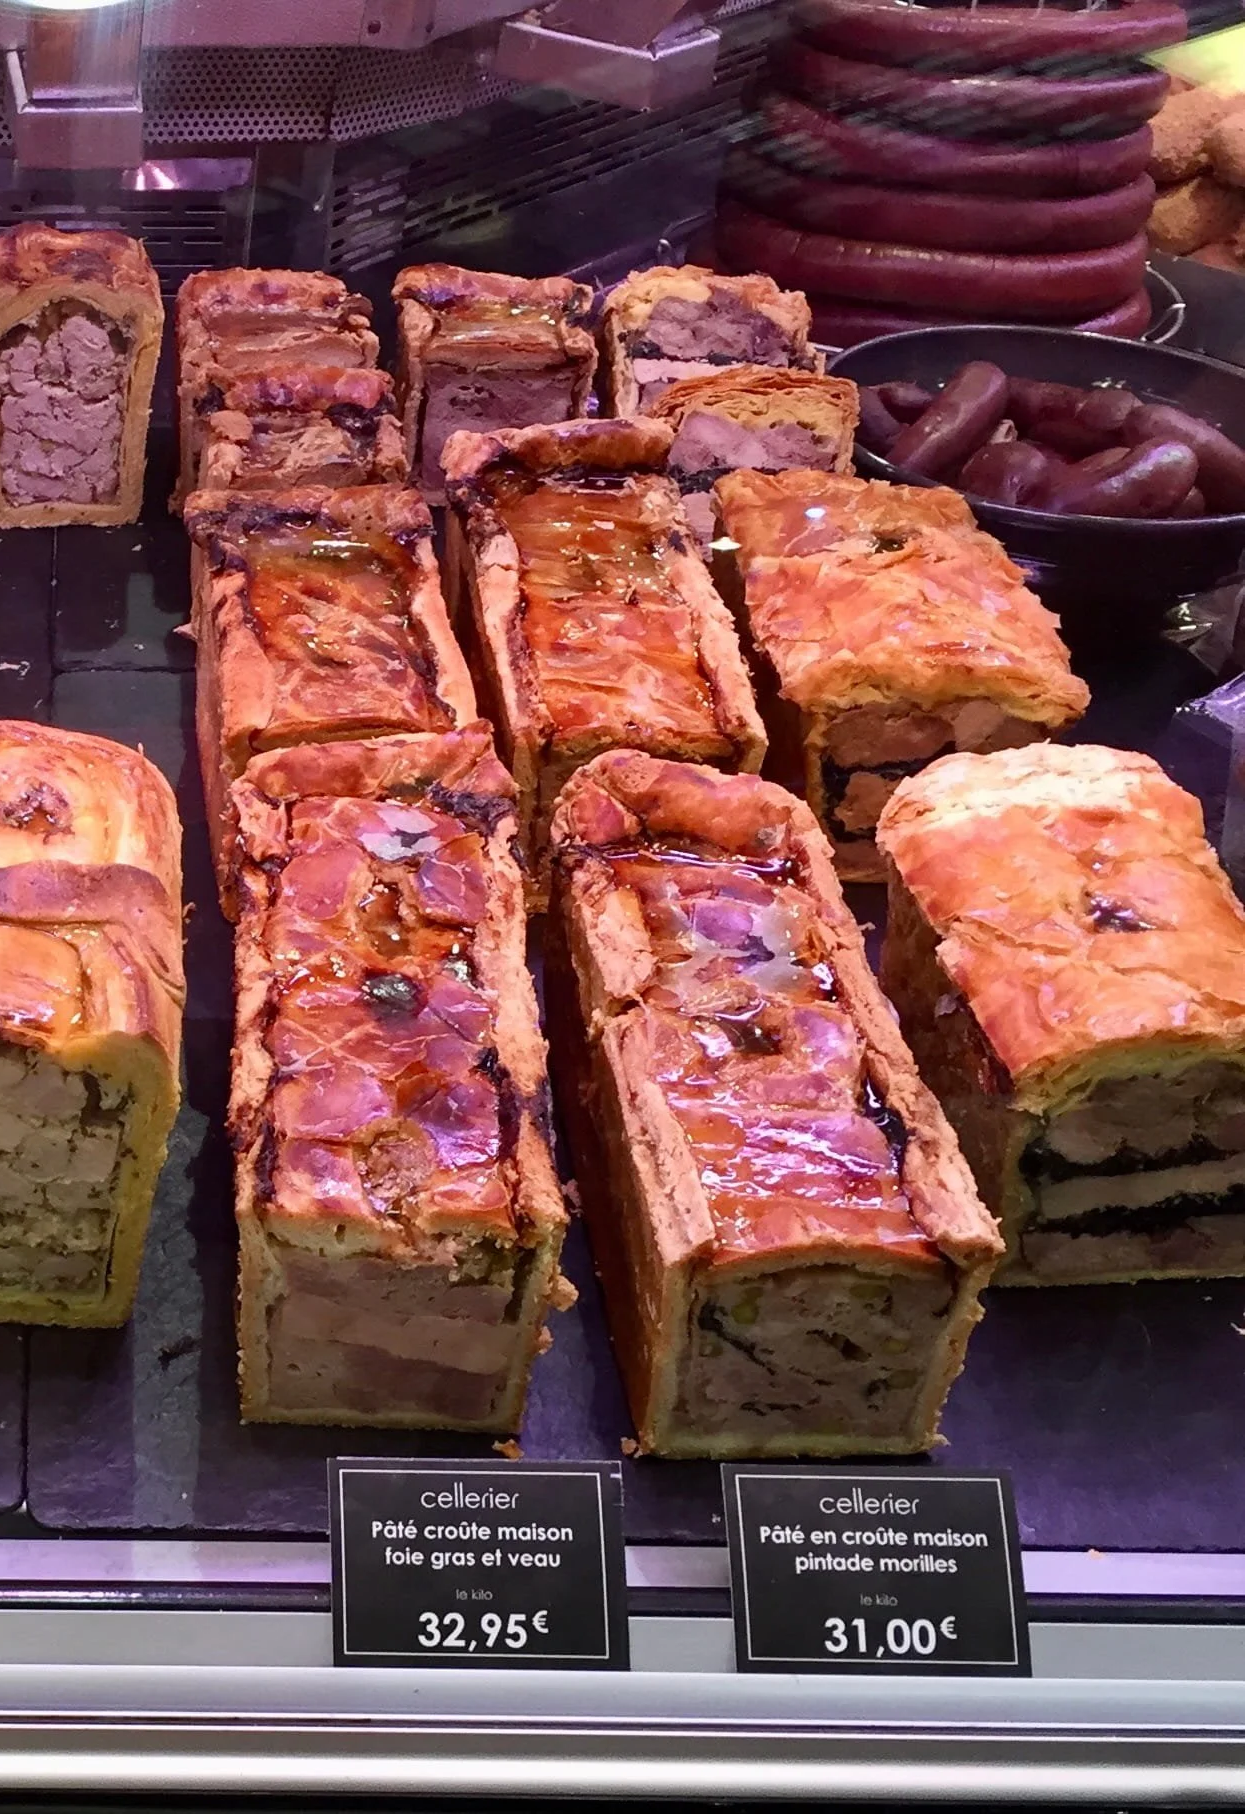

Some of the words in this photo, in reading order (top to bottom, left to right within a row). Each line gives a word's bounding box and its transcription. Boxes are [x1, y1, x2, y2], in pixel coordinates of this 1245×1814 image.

[421, 1482, 519, 1509] cellerier
[820, 1488, 919, 1514] cellerier
[372, 1520, 417, 1538] Pâté
[424, 1522, 491, 1540] croûte
[498, 1523, 572, 1540] maison
[760, 1525, 804, 1544] Pâté
[810, 1531, 836, 1544] en
[842, 1527, 907, 1545] croûte
[914, 1529, 988, 1547] maison
[386, 1547, 424, 1565] foie
[431, 1552, 475, 1569] gras
[482, 1549, 501, 1566] et
[508, 1554, 560, 1567] veau
[796, 1552, 874, 1574] pintade
[880, 1555, 957, 1573] morilles
[455, 1588, 468, 1601] le
[471, 1589, 493, 1601] kilo
[860, 1594, 873, 1606] le
[875, 1594, 898, 1606] kilo
